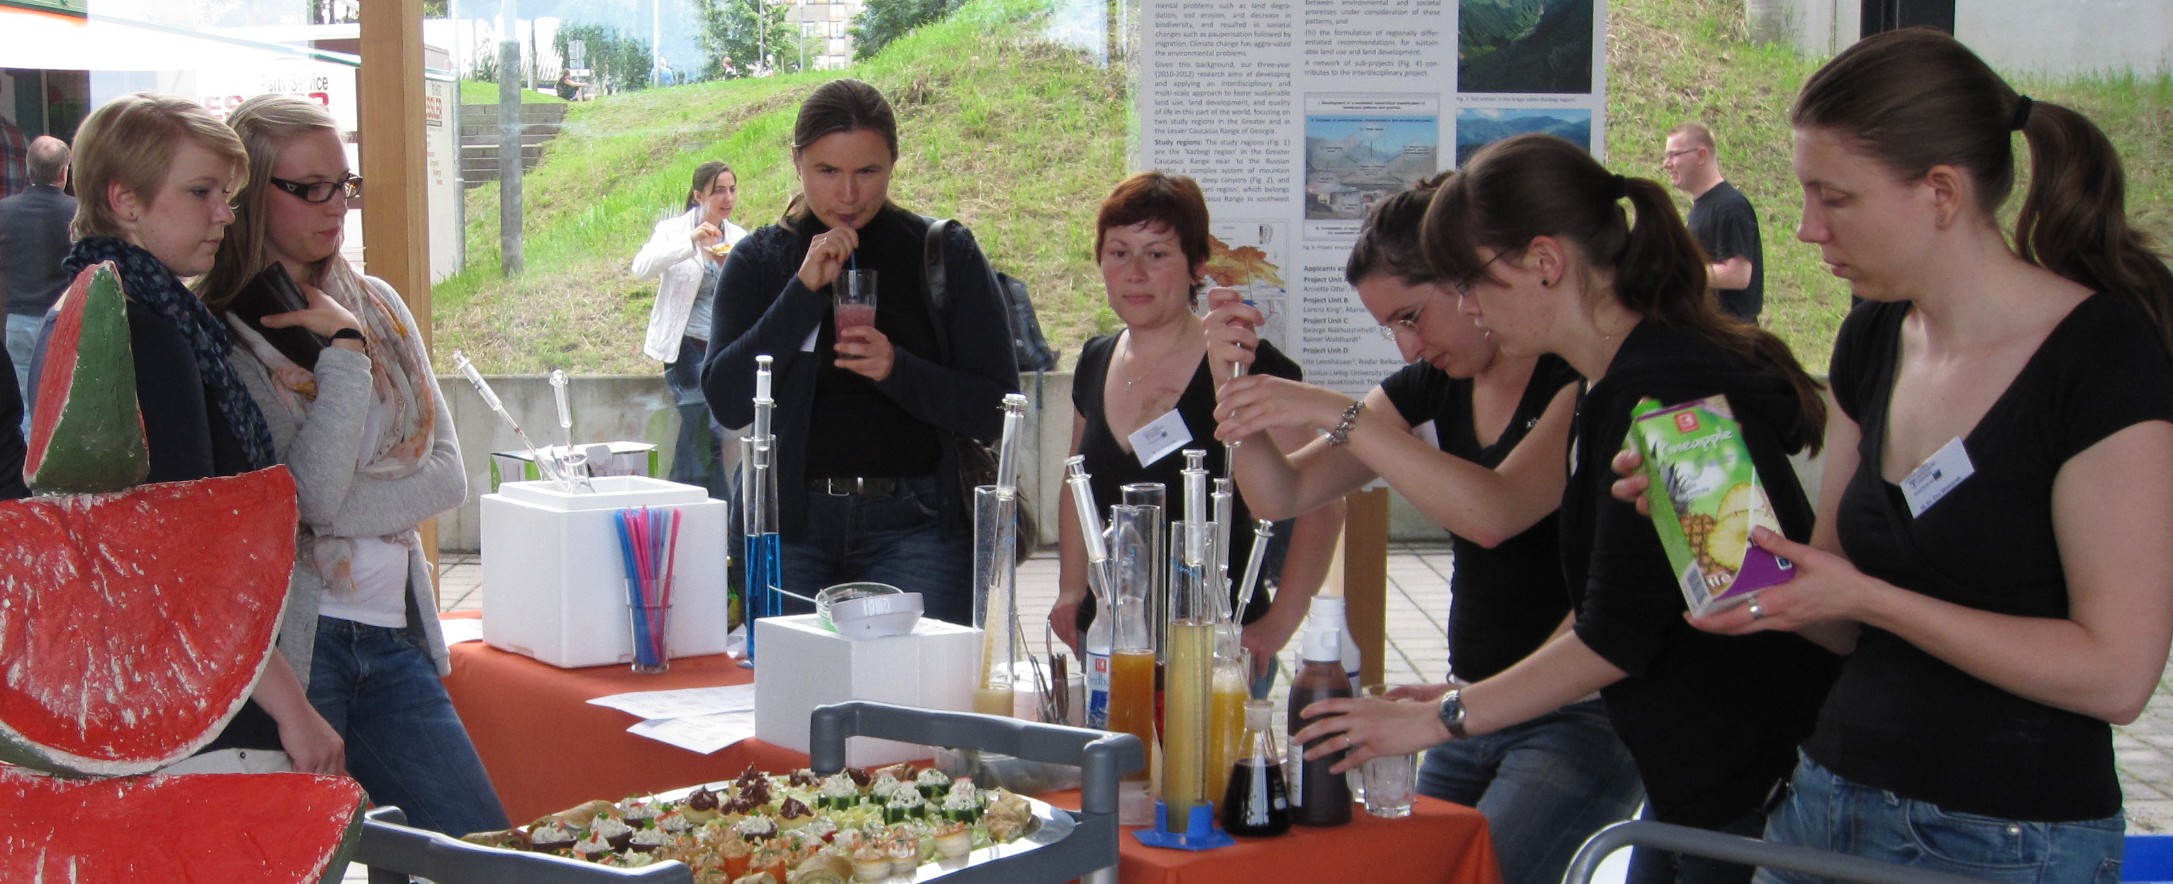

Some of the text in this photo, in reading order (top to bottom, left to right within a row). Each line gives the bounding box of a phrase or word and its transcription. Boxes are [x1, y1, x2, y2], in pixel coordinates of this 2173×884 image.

[1183, 2, 1214, 10] problems
[1155, 31, 1181, 39] changes
[1208, 31, 1252, 39] pauperisation
[1283, 31, 1291, 39] by
[1386, 29, 1417, 37] regionally
[1216, 40, 1239, 48] change
[1256, 70, 1291, 79] developing
[1352, 69, 1403, 77] interdisciplinary
[1173, 80, 1201, 88] applying
[1222, 80, 1272, 88] interdisciplinary
[1192, 89, 1222, 98] approach
[1268, 99, 1290, 107] quality
[1253, 108, 1280, 116] focusing
[1170, 118, 1188, 126] study
[1191, 118, 1215, 126] regions
[1220, 127, 1240, 135] Range
[1154, 139, 1173, 147] Study
[1220, 139, 1238, 147] study
[1240, 139, 1264, 147] regions
[1190, 157, 1210, 166] Range
[1190, 167, 1217, 175] complex
[1202, 176, 1218, 184] deep
[1265, 185, 1289, 194] belongs
[1224, 195, 1244, 203] Range
[1303, 317, 1327, 325] Project
